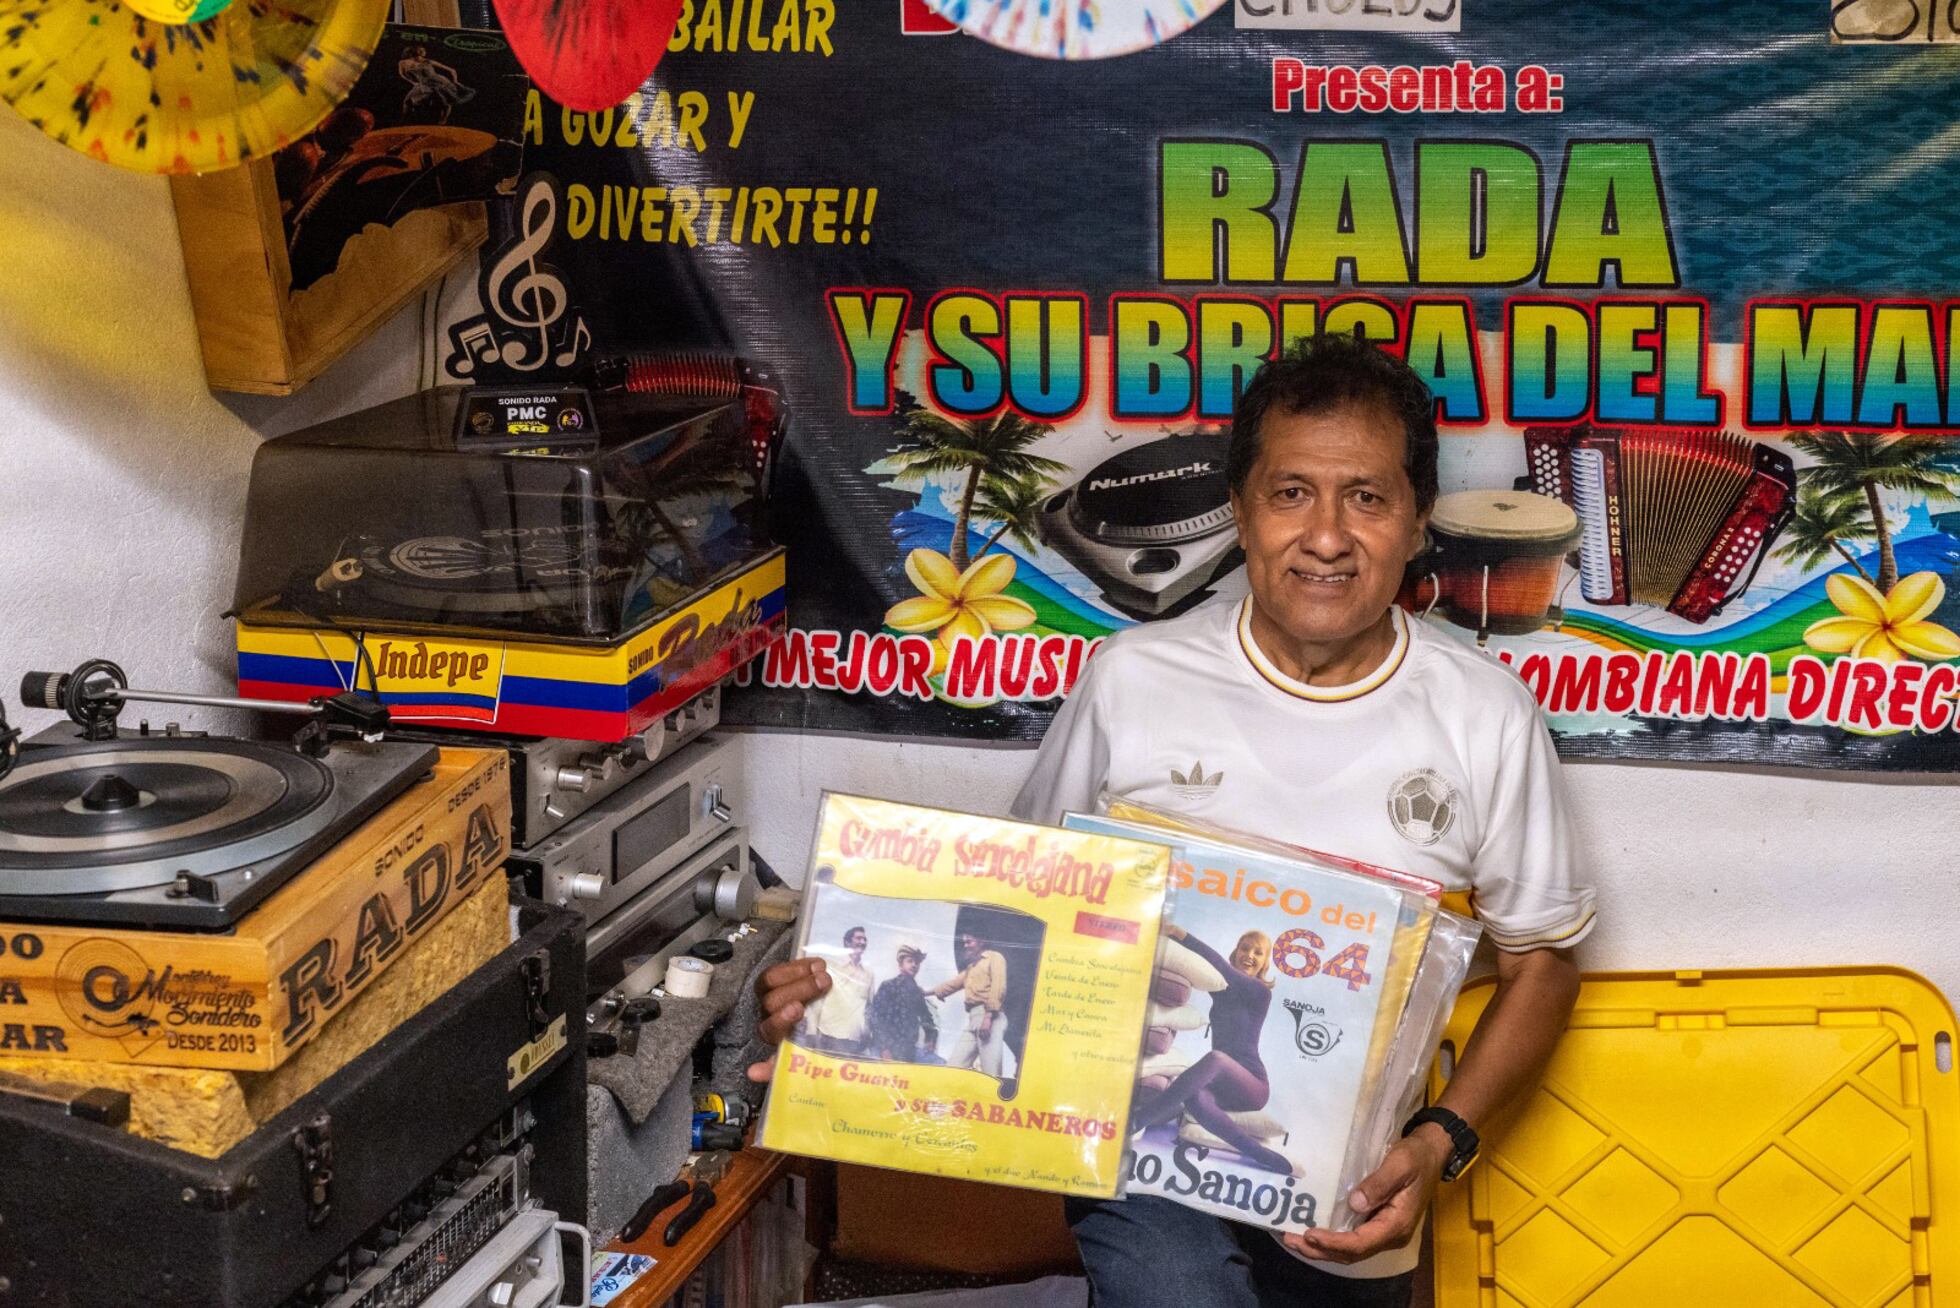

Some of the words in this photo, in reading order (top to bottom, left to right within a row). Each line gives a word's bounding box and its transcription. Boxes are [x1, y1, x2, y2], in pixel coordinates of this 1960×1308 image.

[1273, 57, 1505, 112] Presenta
[1516, 65, 1564, 113] a:
[524, 88, 544, 146] A
[561, 91, 709, 153] GOZAR
[728, 91, 755, 149] Y
[566, 184, 878, 249] DIVERTIRTE!!
[1159, 138, 1681, 288] RADA
[827, 289, 910, 416] Y
[928, 290, 1086, 420] SU
[1505, 298, 1725, 427] DEL
[1745, 302, 1960, 430] MA
[498, 397, 531, 405] SONIDO
[533, 396, 557, 404] RADA
[507, 407, 547, 421] PMC
[1089, 461, 1212, 491] Numark
[1609, 495, 1622, 557] HOHNER
[375, 641, 489, 688] Indepe
[764, 630, 934, 701] MEJOR
[1497, 650, 1770, 720] OMBIANA
[1786, 655, 1960, 731] DIREC
[374, 823, 424, 877] SONIDO
[278, 802, 504, 1048] RADA
[1320, 903, 1377, 935] del
[0, 932, 44, 961] O
[1272, 927, 1371, 993] 64
[1, 1022, 70, 1052] AR
[166, 1031, 216, 1051] DESDE
[218, 1032, 257, 1054] 2013
[1303, 1029, 1325, 1050] S
[786, 1053, 834, 1079] Pipe
[950, 1098, 1118, 1142] SABANEROS
[1164, 1142, 1318, 1229] Sanoja
